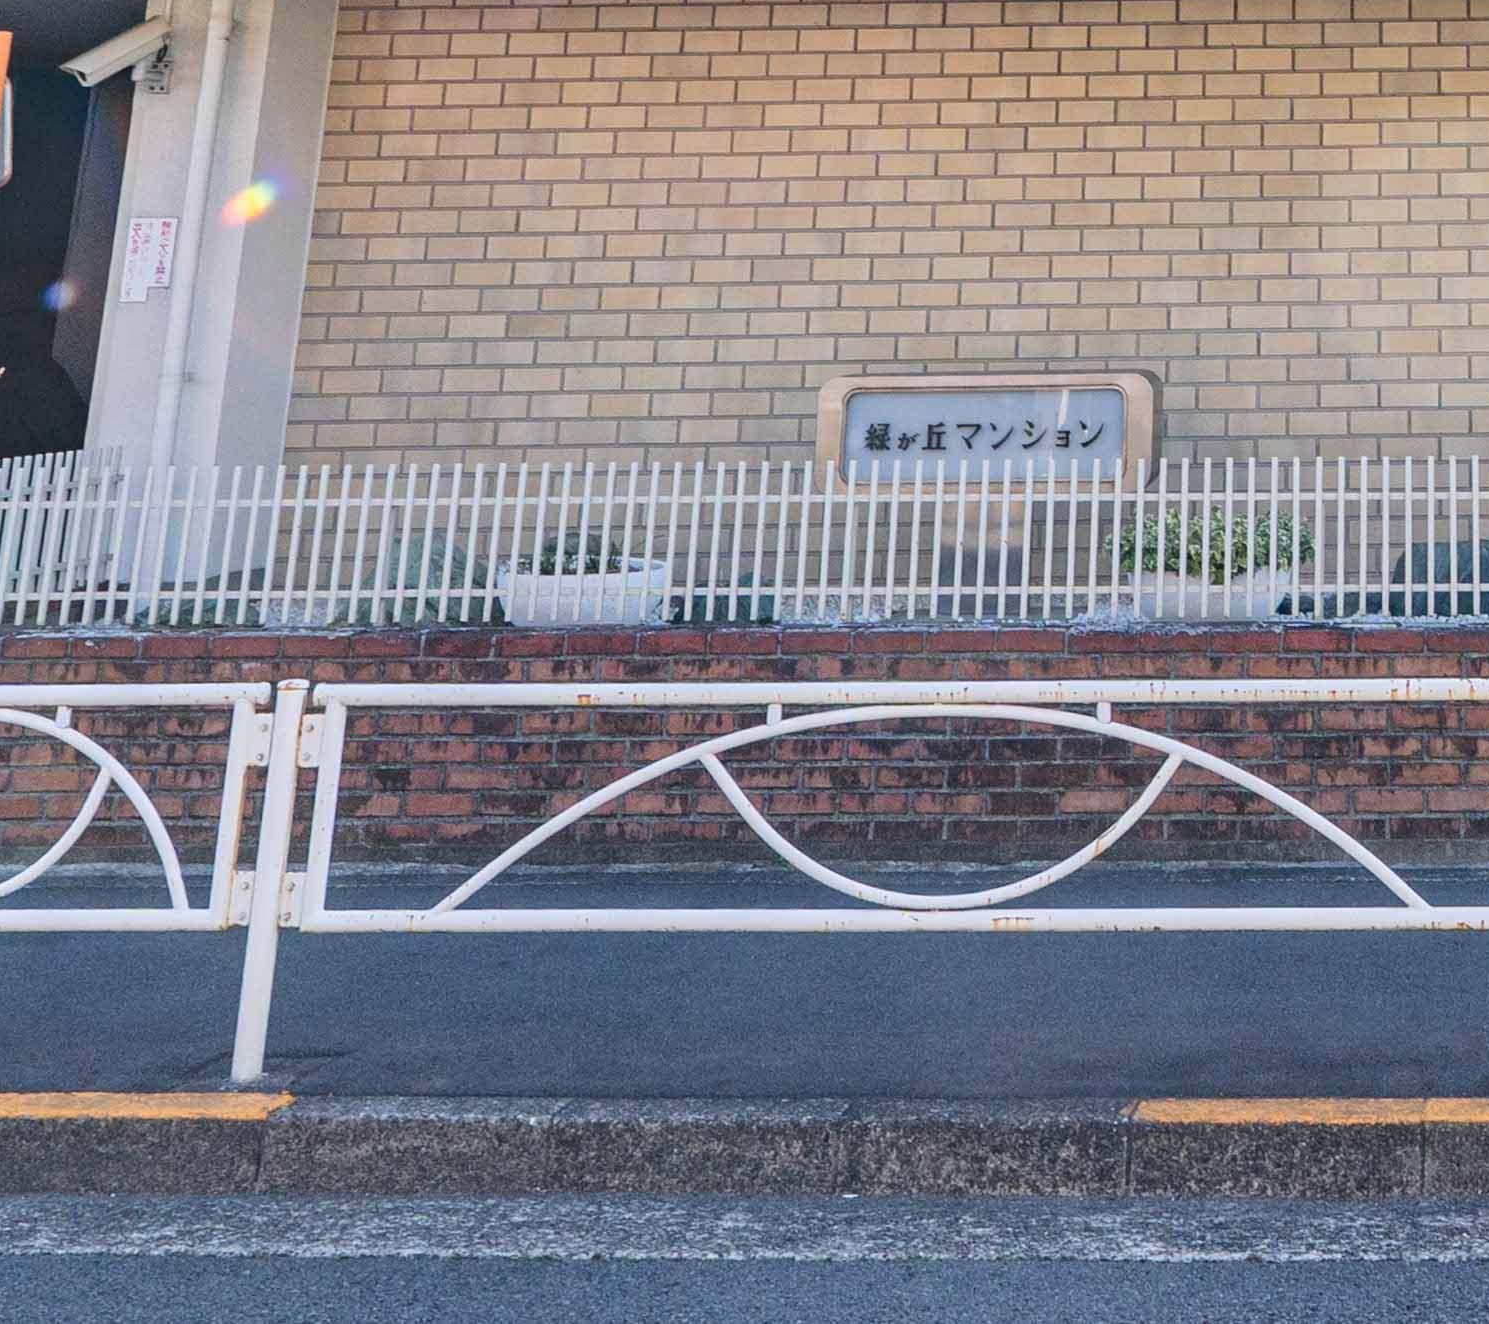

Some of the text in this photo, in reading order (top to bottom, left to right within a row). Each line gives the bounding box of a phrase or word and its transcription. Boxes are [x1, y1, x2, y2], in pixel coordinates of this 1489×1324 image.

[864, 419, 1105, 452] 緑が丘マンション
